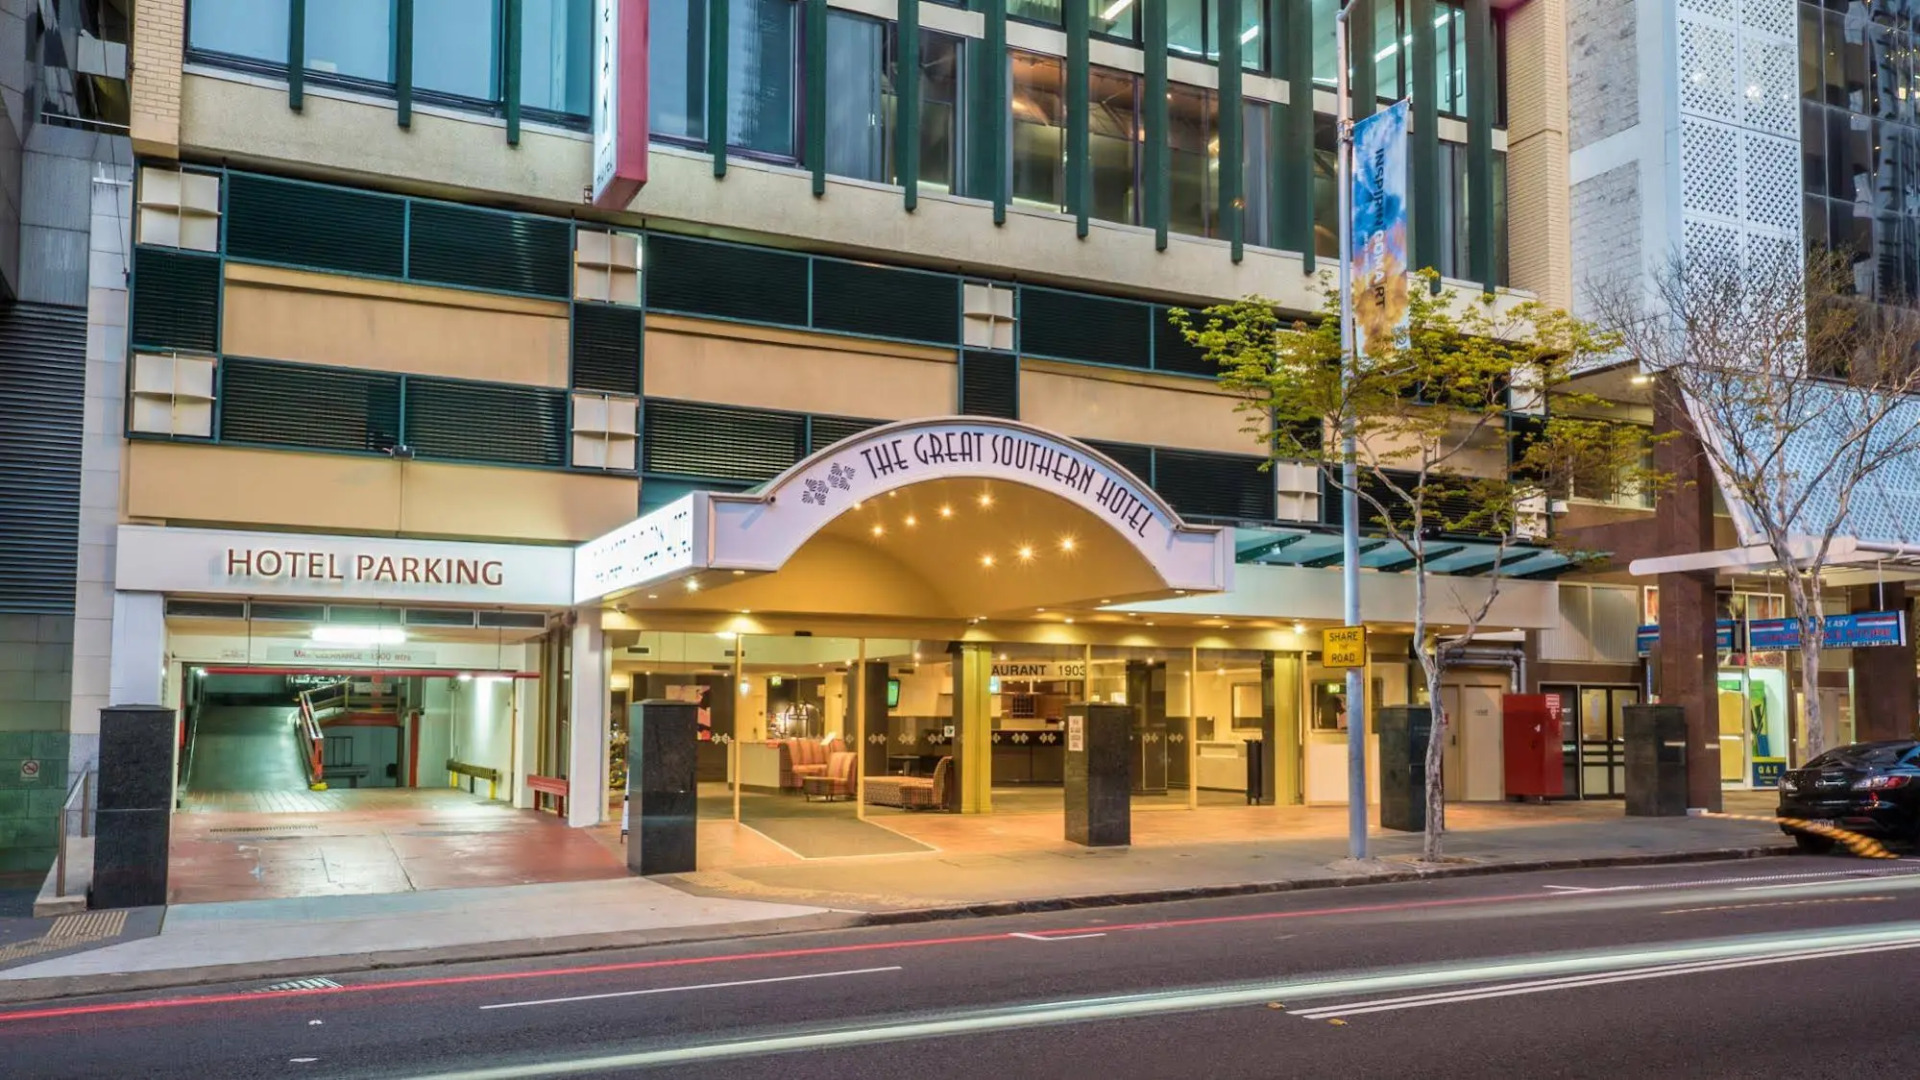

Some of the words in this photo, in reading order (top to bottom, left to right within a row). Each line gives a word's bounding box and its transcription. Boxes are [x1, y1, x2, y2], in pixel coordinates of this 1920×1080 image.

[861, 440, 909, 479] THE
[913, 432, 984, 466] GREAT
[991, 434, 1096, 495] SOUTHERN
[1096, 477, 1154, 538] HOTEL
[227, 549, 344, 580] HOTEL
[356, 554, 503, 586] PARKING
[1329, 631, 1358, 641] SHARE
[1331, 653, 1355, 662] ROAD
[991, 665, 1046, 676] AURANT
[1059, 665, 1085, 676] 1903
